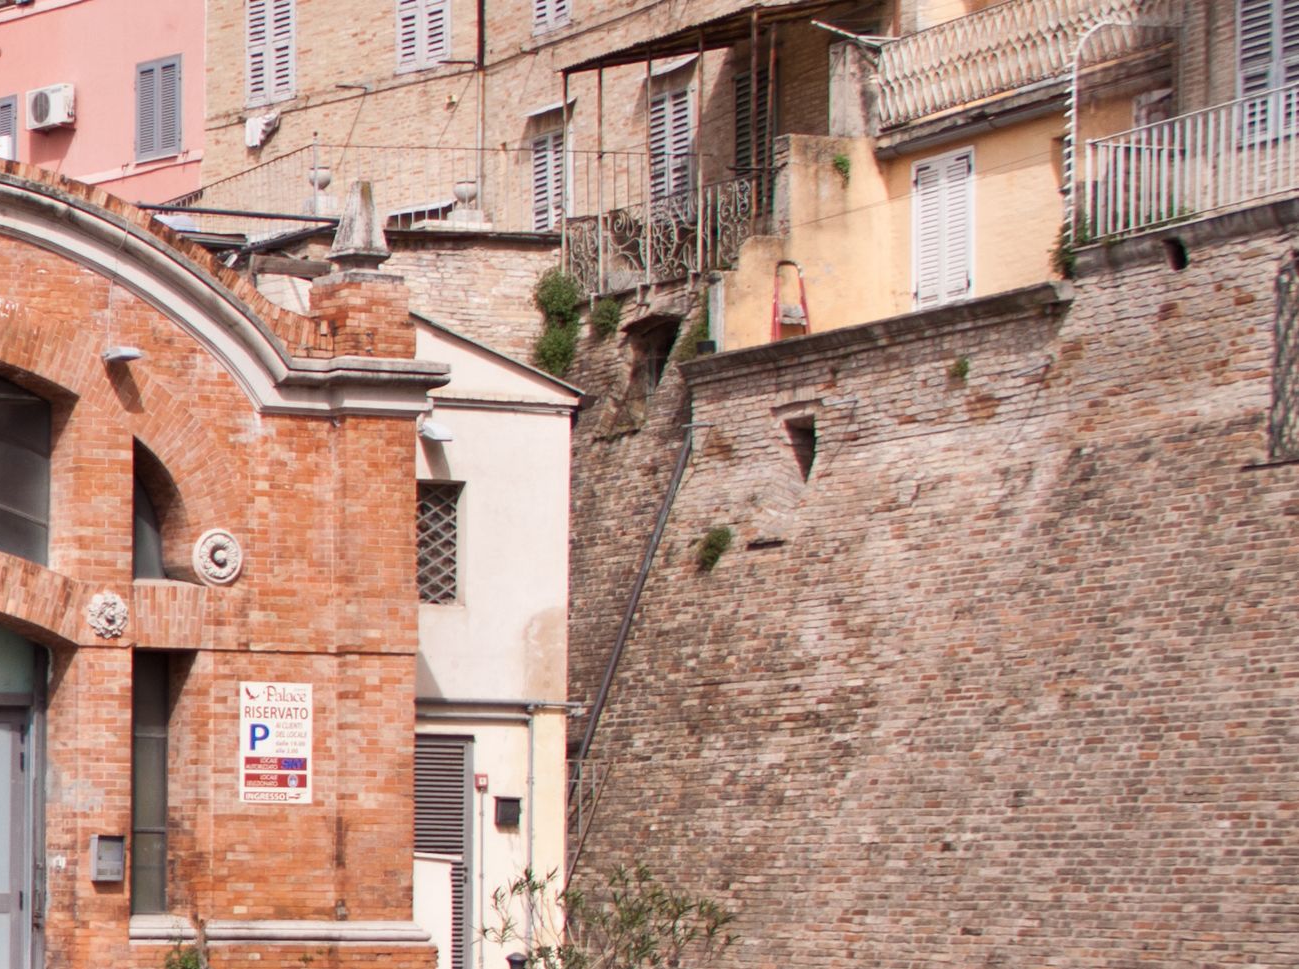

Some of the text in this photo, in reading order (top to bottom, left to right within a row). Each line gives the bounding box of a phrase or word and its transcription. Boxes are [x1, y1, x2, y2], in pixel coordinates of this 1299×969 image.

[244, 705, 309, 720] RISERVATO
[249, 723, 270, 751] P
[245, 792, 286, 800] INGRESSO
